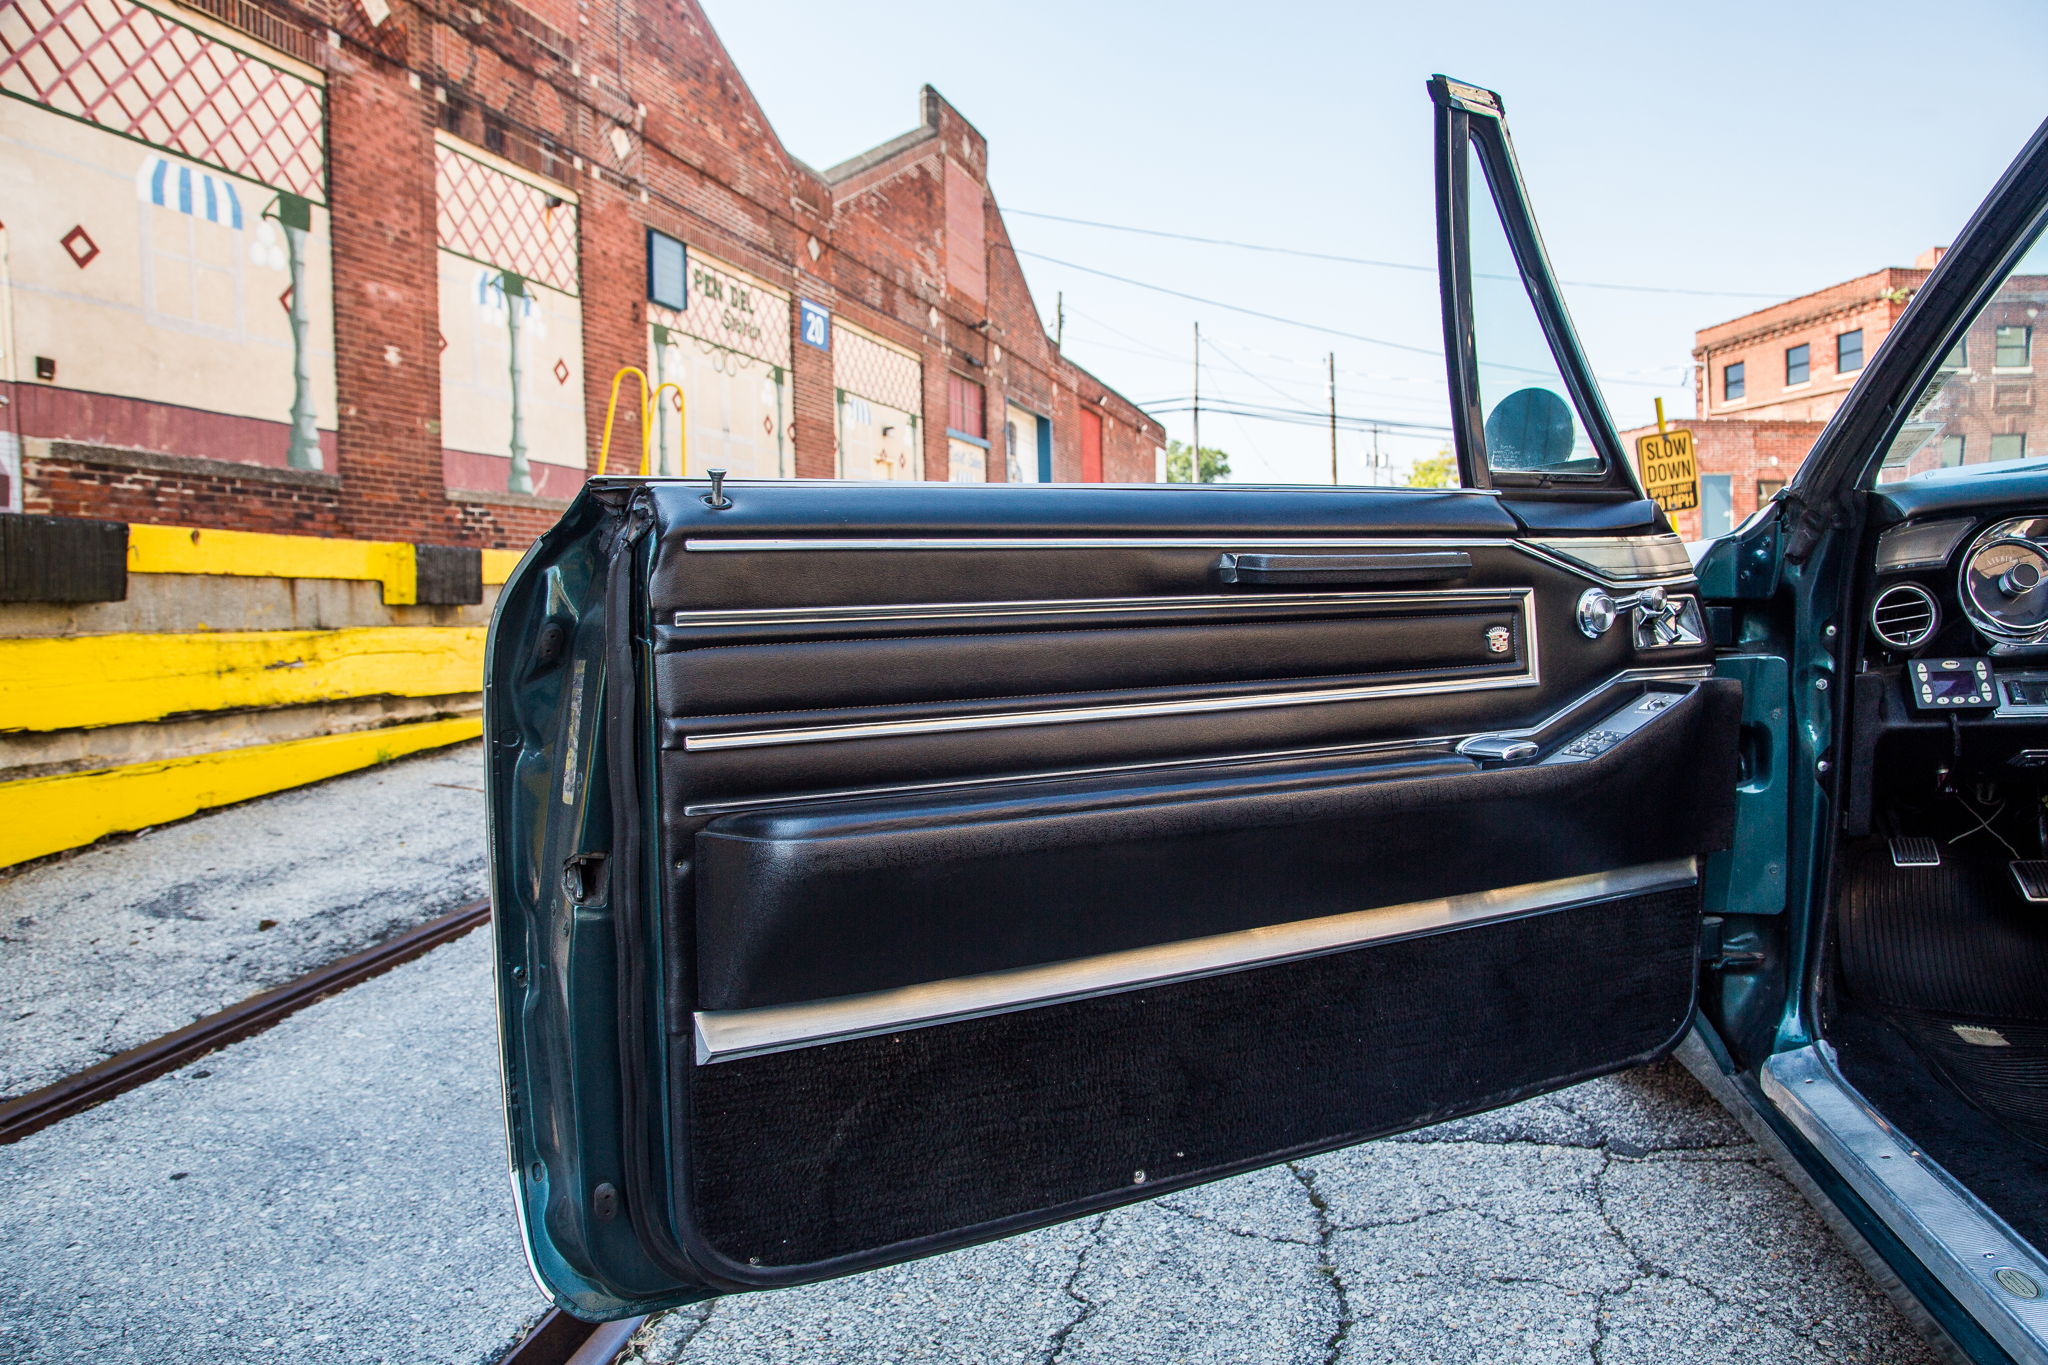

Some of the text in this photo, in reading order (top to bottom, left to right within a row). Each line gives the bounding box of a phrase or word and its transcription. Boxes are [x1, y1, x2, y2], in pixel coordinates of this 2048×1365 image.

[806, 312, 825, 346] 20
[1647, 438, 1686, 460] SLOW
[1648, 460, 1691, 483] DOWN
[1667, 493, 1694, 510] MPH
